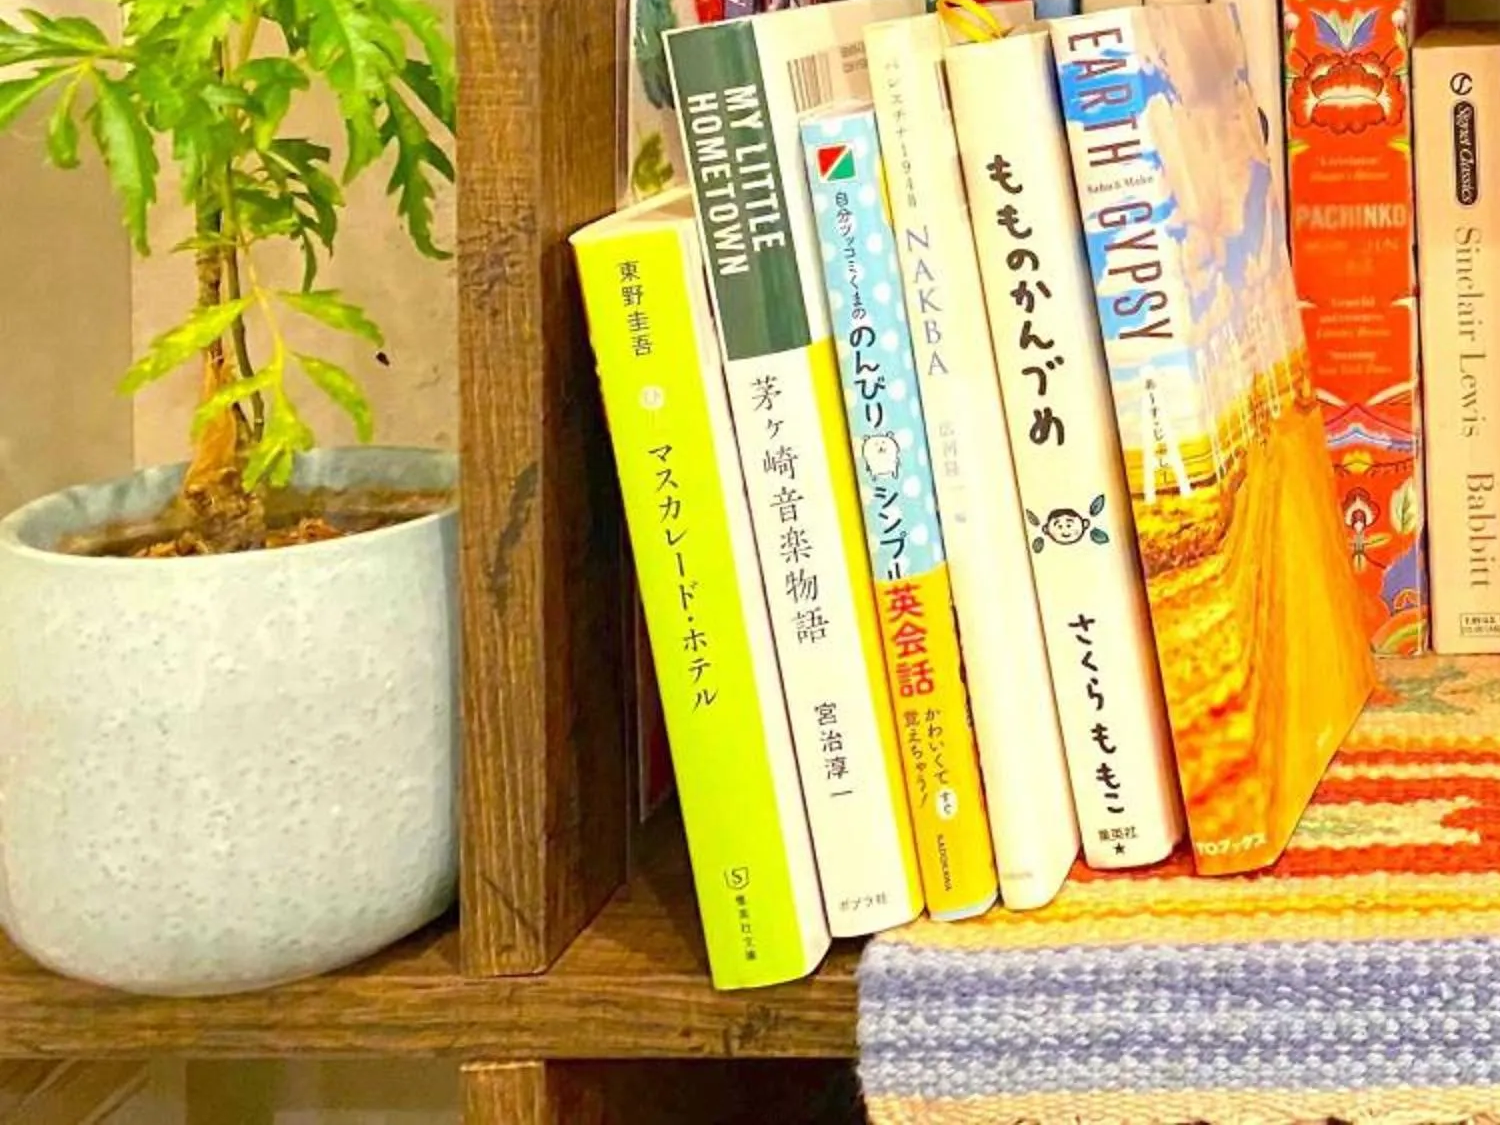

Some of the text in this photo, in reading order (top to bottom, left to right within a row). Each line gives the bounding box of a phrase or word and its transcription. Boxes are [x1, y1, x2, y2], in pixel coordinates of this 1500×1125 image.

[723, 83, 786, 253] MY LITTLE
[1067, 26, 1143, 168] EARTH
[686, 91, 750, 277] HOMETOWN
[1296, 202, 1408, 232] PACHINKO
[615, 259, 654, 358] 東野圭吾
[905, 226, 950, 377] NAKBA
[985, 152, 1067, 447] もものかんづめ
[1097, 201, 1174, 341] GYPSY
[1454, 225, 1488, 440] Sinclair Lewis
[648, 442, 720, 713] マスカレード・ホテル
[849, 325, 886, 429] のんびり
[885, 582, 936, 699] 英会話
[1465, 472, 1498, 589] Babbitt
[813, 701, 854, 800] 宮治淳一
[1068, 613, 1125, 816] さくらももこ
